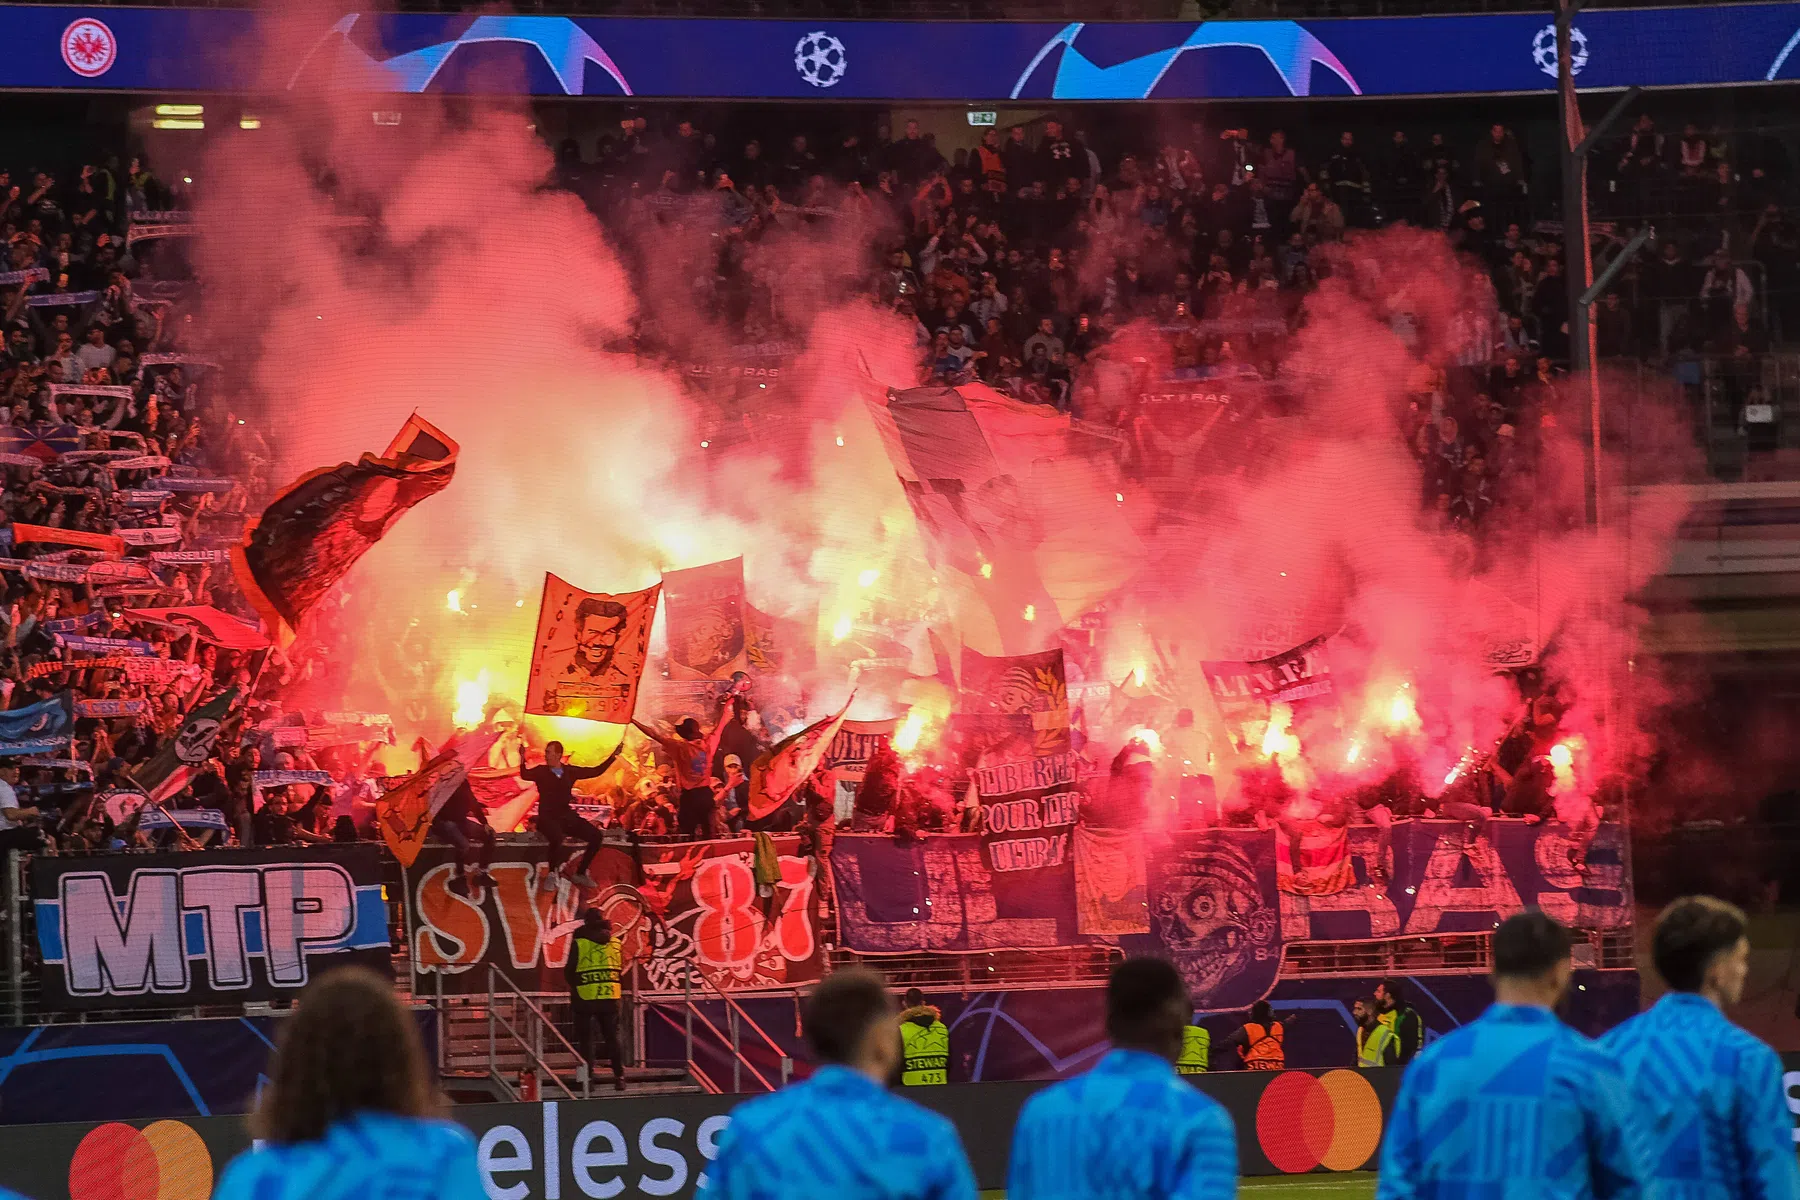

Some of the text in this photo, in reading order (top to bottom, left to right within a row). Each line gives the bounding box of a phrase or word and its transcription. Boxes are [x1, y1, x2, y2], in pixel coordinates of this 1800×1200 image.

[980, 798, 1042, 836] POUR
[989, 833, 1069, 872] ULTRA
[58, 862, 357, 997] MTP
[692, 851, 817, 970] 87
[580, 970, 620, 984] STEWAR
[905, 1056, 949, 1070] STEWAR
[920, 1072, 941, 1084] 473
